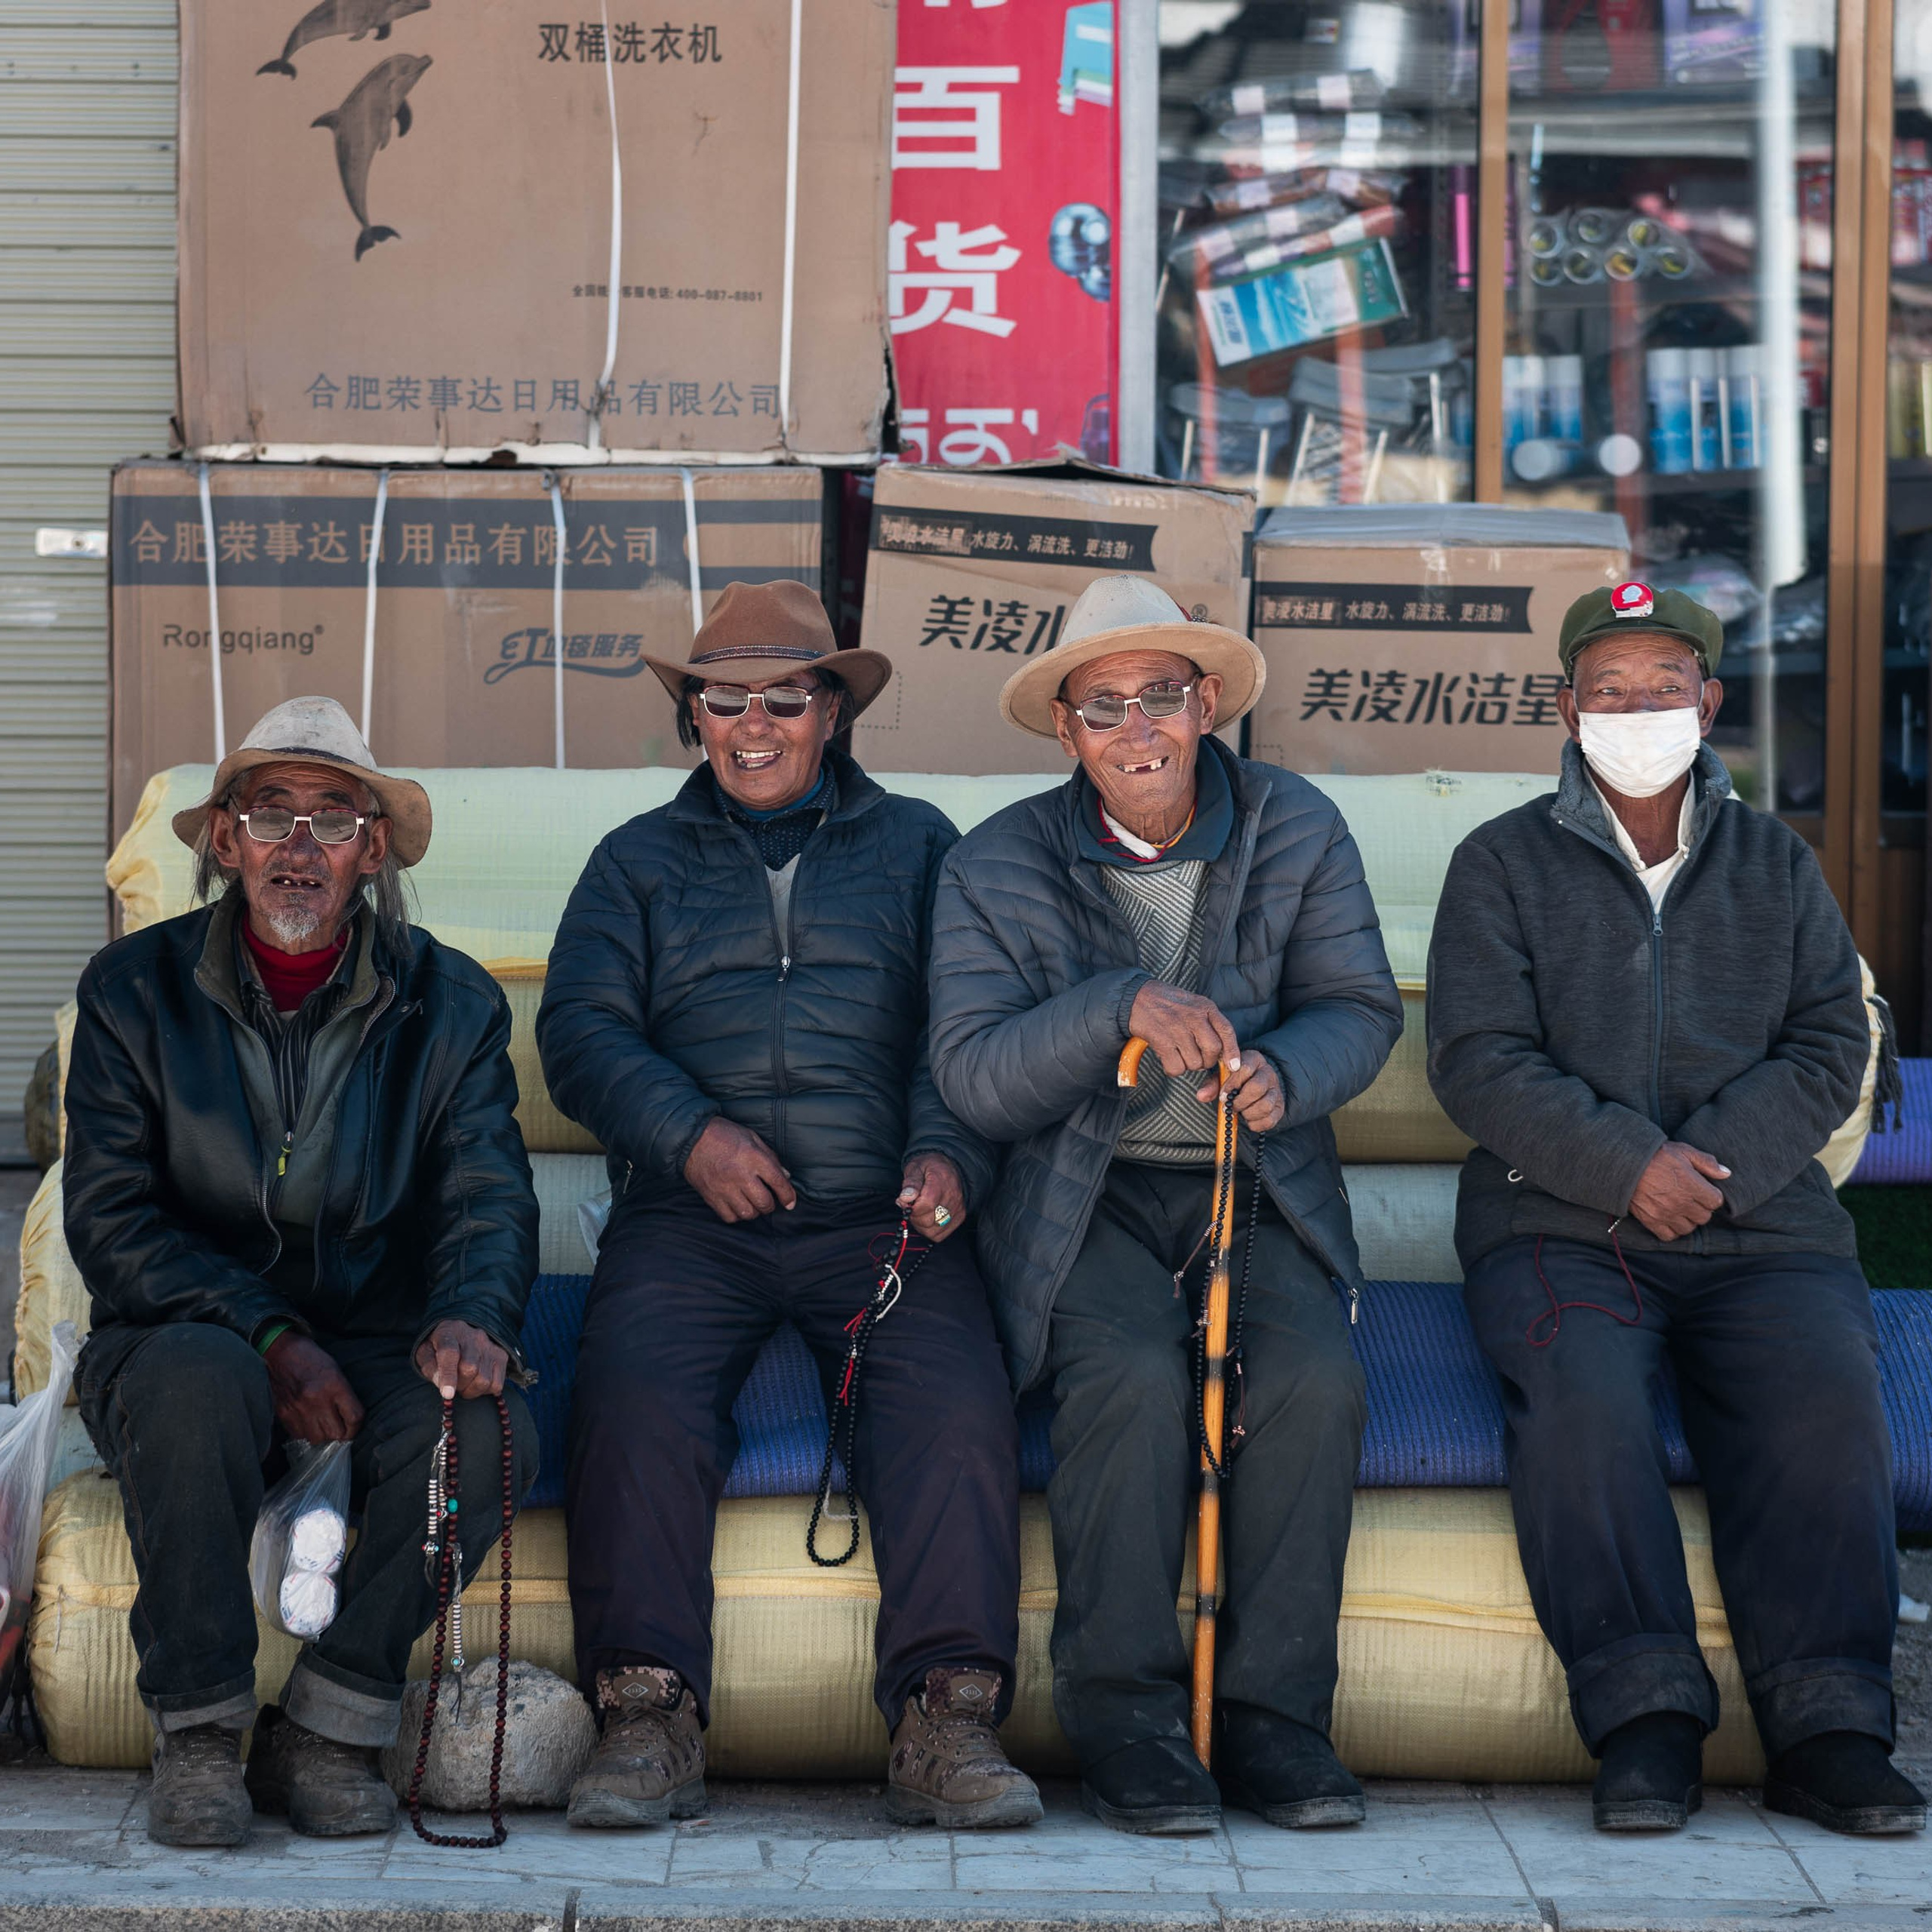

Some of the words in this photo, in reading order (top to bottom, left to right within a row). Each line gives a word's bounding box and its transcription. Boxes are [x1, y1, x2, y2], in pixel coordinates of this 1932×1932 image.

[538, 22, 722, 63] 双桶洗衣机
[888, 0, 1023, 337] 百货
[305, 373, 780, 420] 合肥荣事达日用品有限公司
[130, 519, 658, 566] 合肥荣事达日用品有限公司
[1300, 669, 1565, 726] 美凌水洁星
